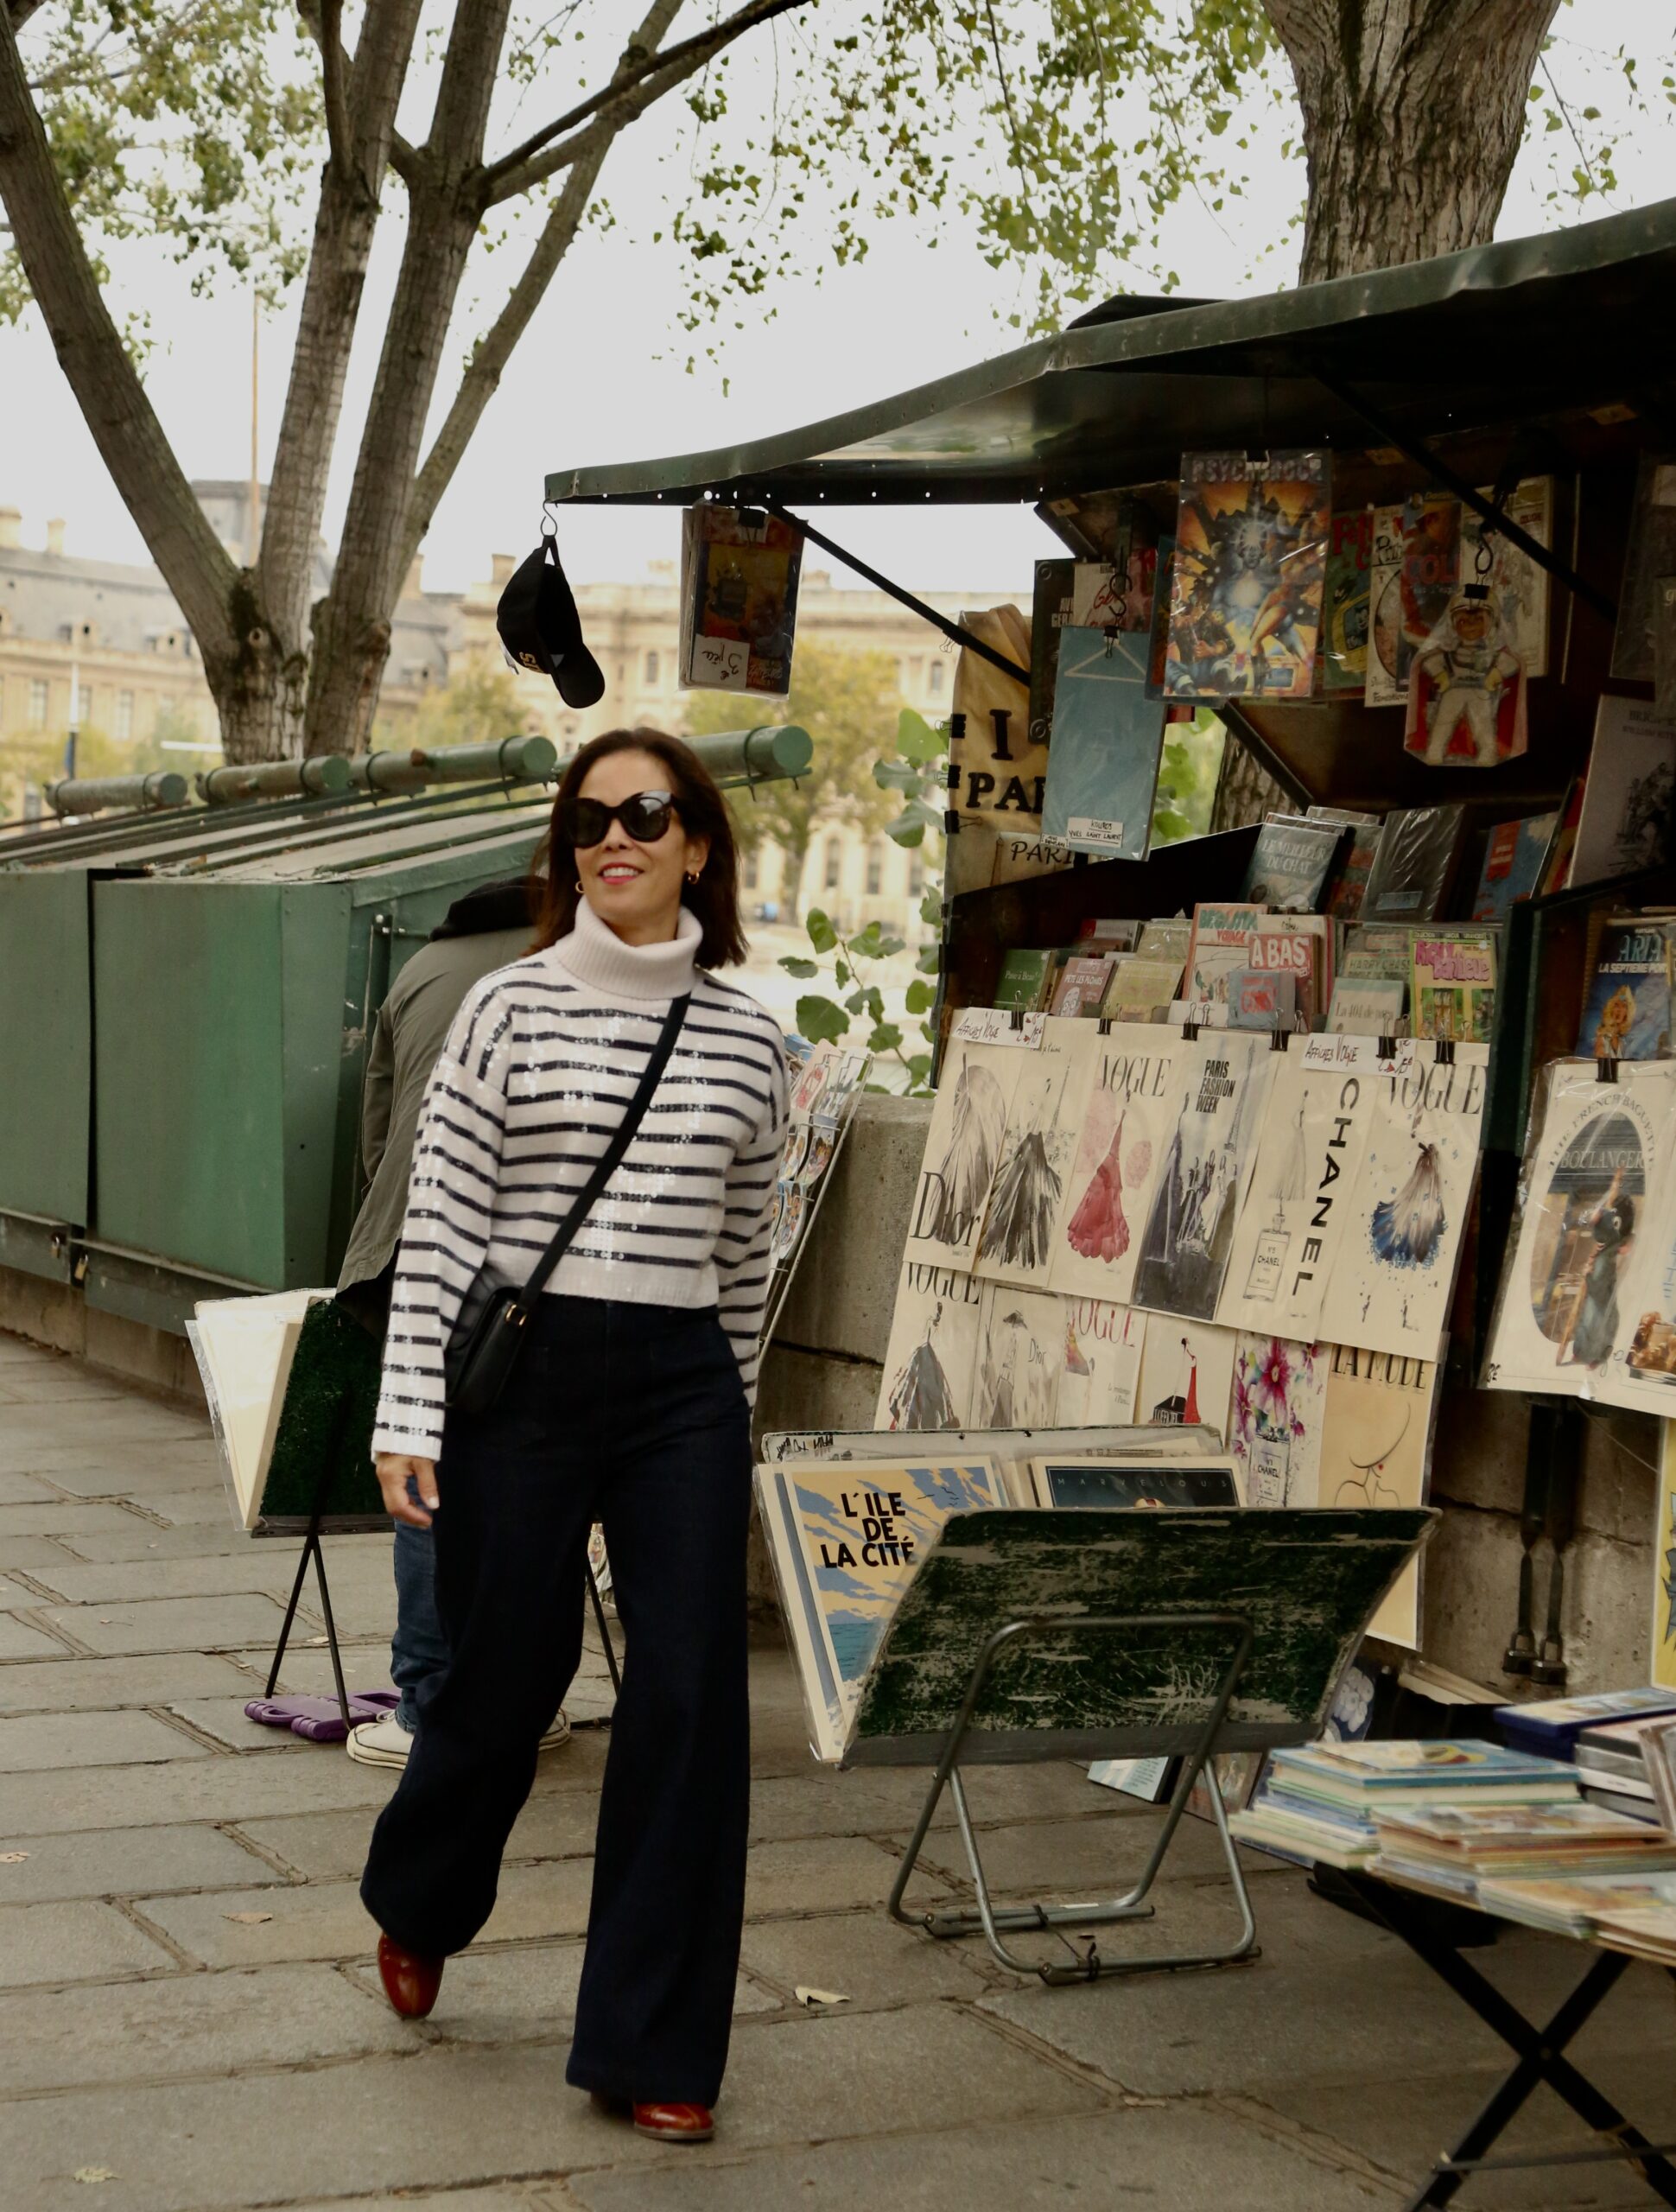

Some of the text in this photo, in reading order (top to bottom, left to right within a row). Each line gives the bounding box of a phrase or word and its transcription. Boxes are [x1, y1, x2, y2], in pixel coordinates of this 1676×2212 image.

[989, 709, 1013, 760] I
[1283, 858, 1313, 874] CHAT
[1267, 937, 1310, 969] BAS
[1617, 935, 1662, 962] ARIA
[1100, 1054, 1171, 1097] VOGUE
[1204, 1059, 1229, 1078] PARIS
[1200, 1077, 1235, 1097] FASHION
[1196, 1095, 1220, 1114] WEEK
[1292, 1077, 1361, 1296] CHANEL
[910, 1171, 981, 1247] Dior
[1258, 1255, 1279, 1267] CHANEL
[1028, 1338, 1046, 1365] Dior
[1057, 1478, 1228, 1488] MARVELOUS
[862, 1517, 898, 1542] DE
[820, 1536, 915, 1568] LA CITÉ
